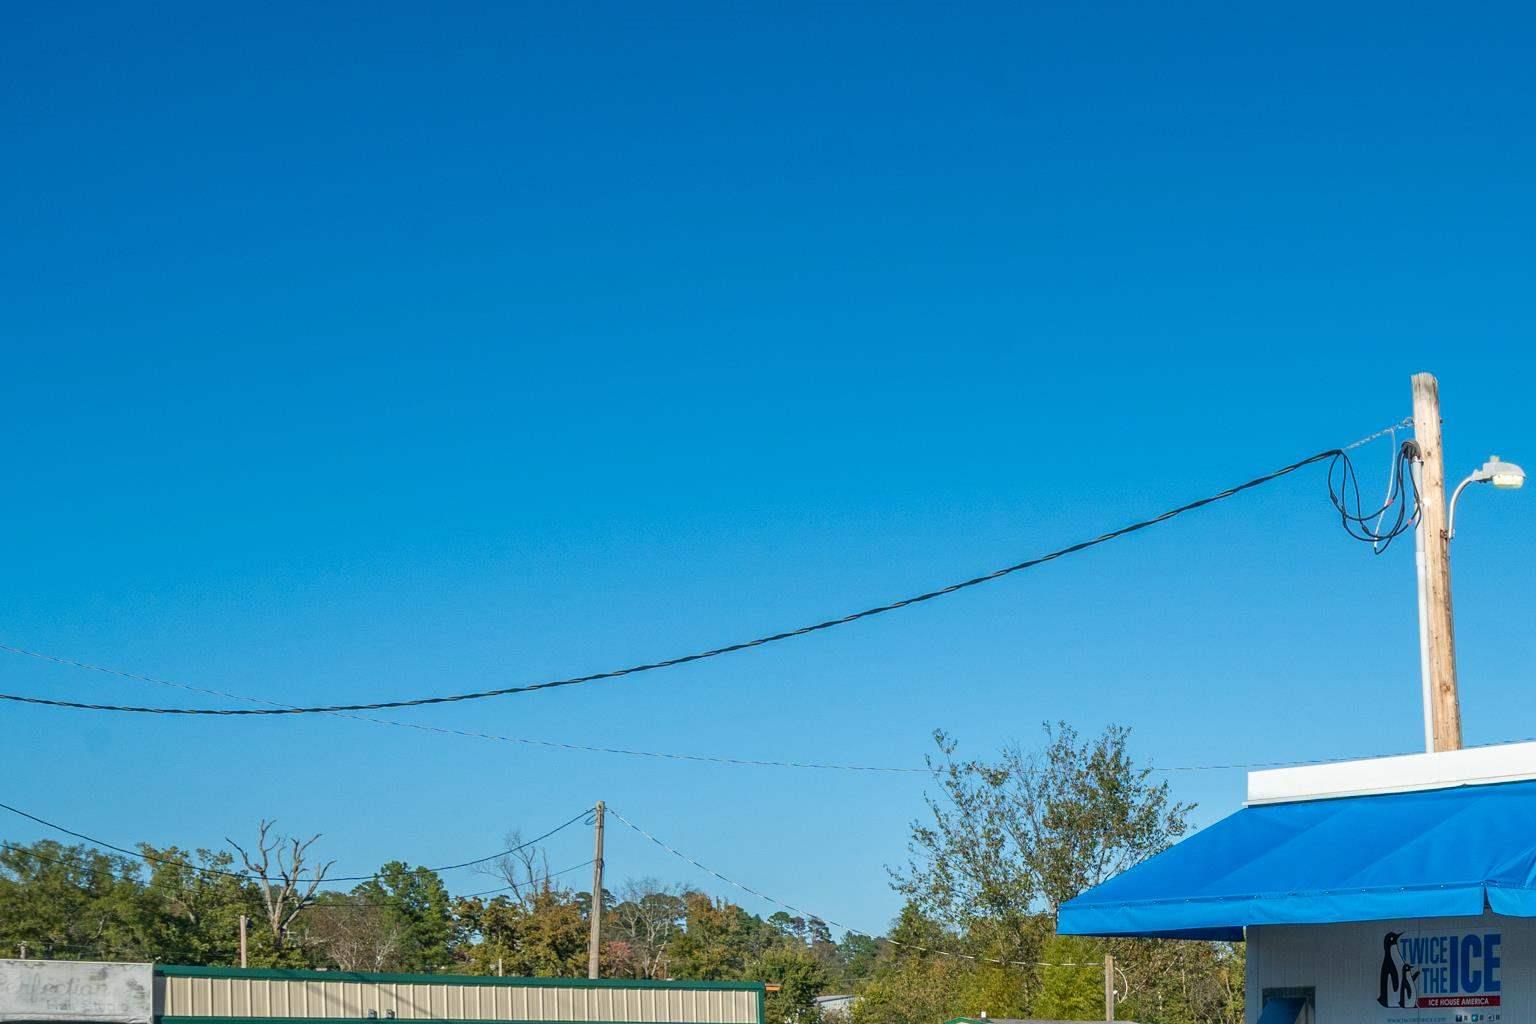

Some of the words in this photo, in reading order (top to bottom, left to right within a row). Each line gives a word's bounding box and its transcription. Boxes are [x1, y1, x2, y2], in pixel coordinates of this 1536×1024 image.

[1400, 936, 1449, 965] TWICE
[1449, 933, 1501, 994] ICE
[1421, 967, 1449, 994] THE
[1440, 998, 1460, 1006] HOUSE
